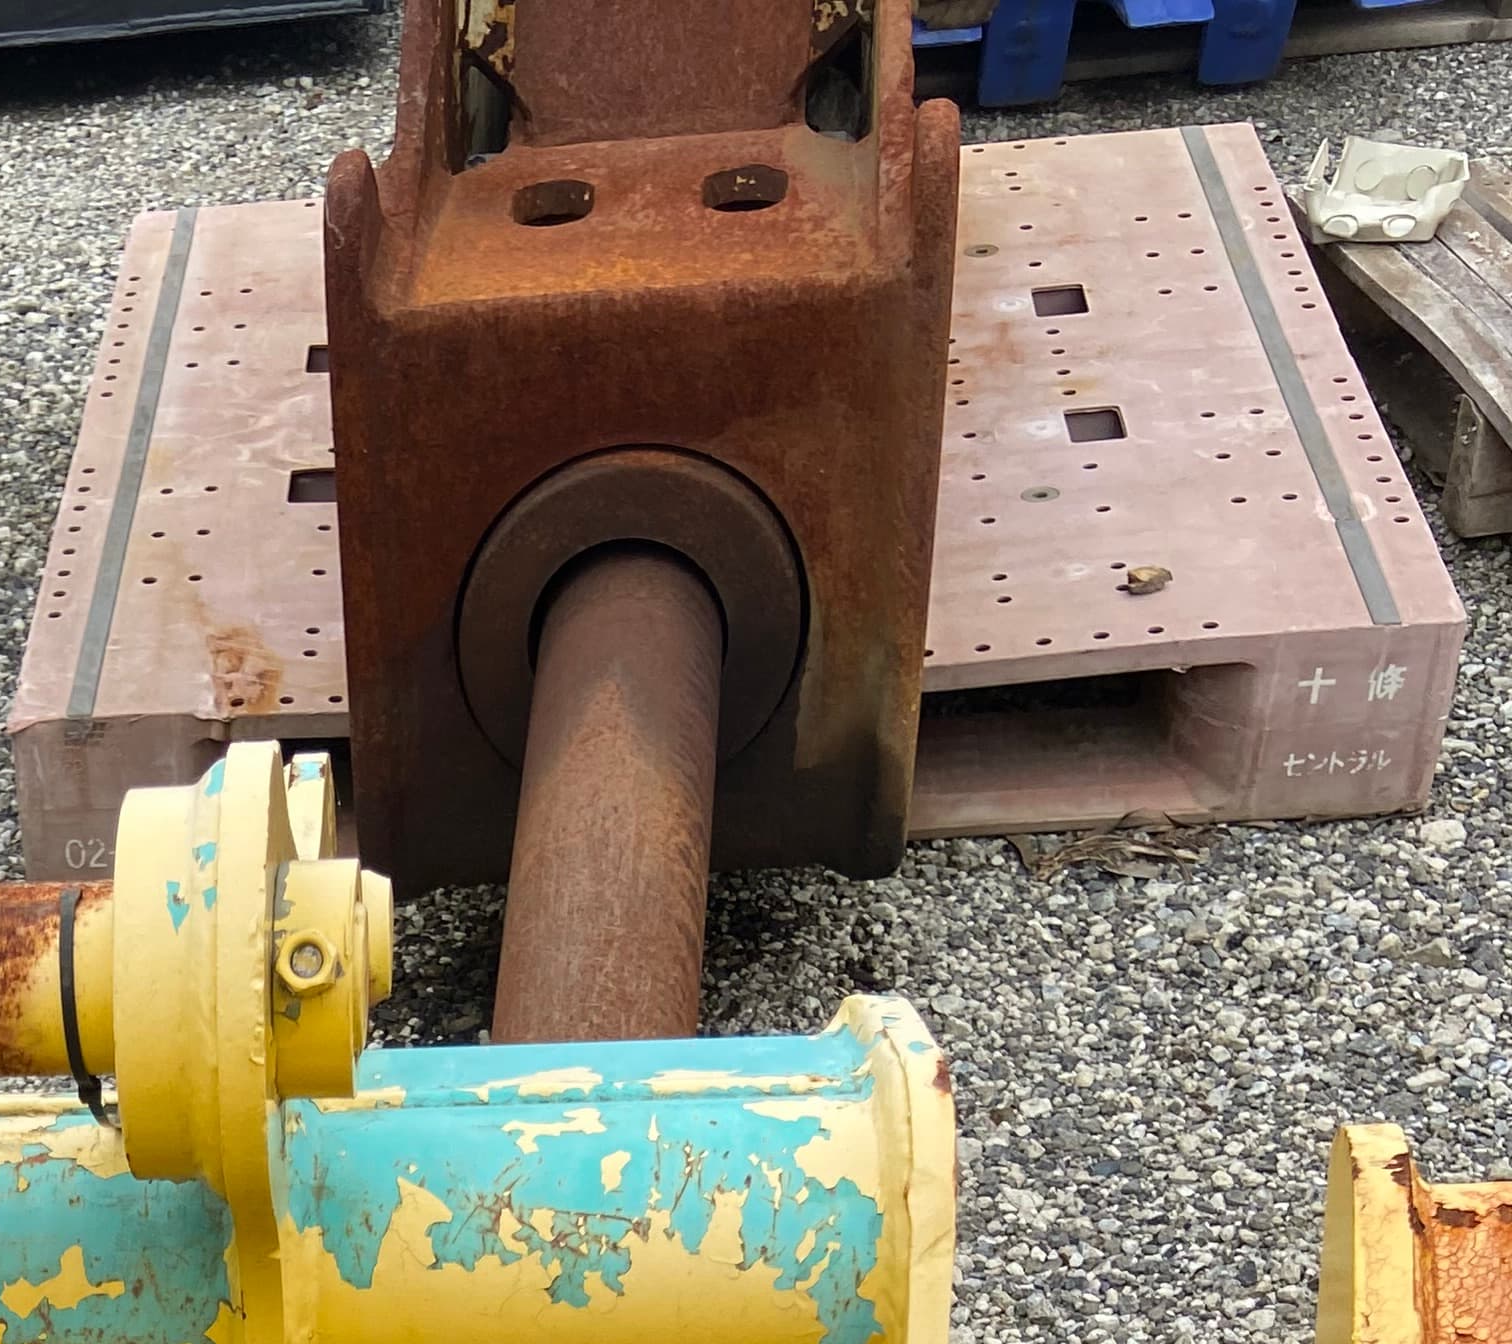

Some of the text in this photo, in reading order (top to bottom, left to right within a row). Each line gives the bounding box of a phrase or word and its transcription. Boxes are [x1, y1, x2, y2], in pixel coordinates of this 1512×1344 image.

[1283, 750, 1392, 777] セントラル
